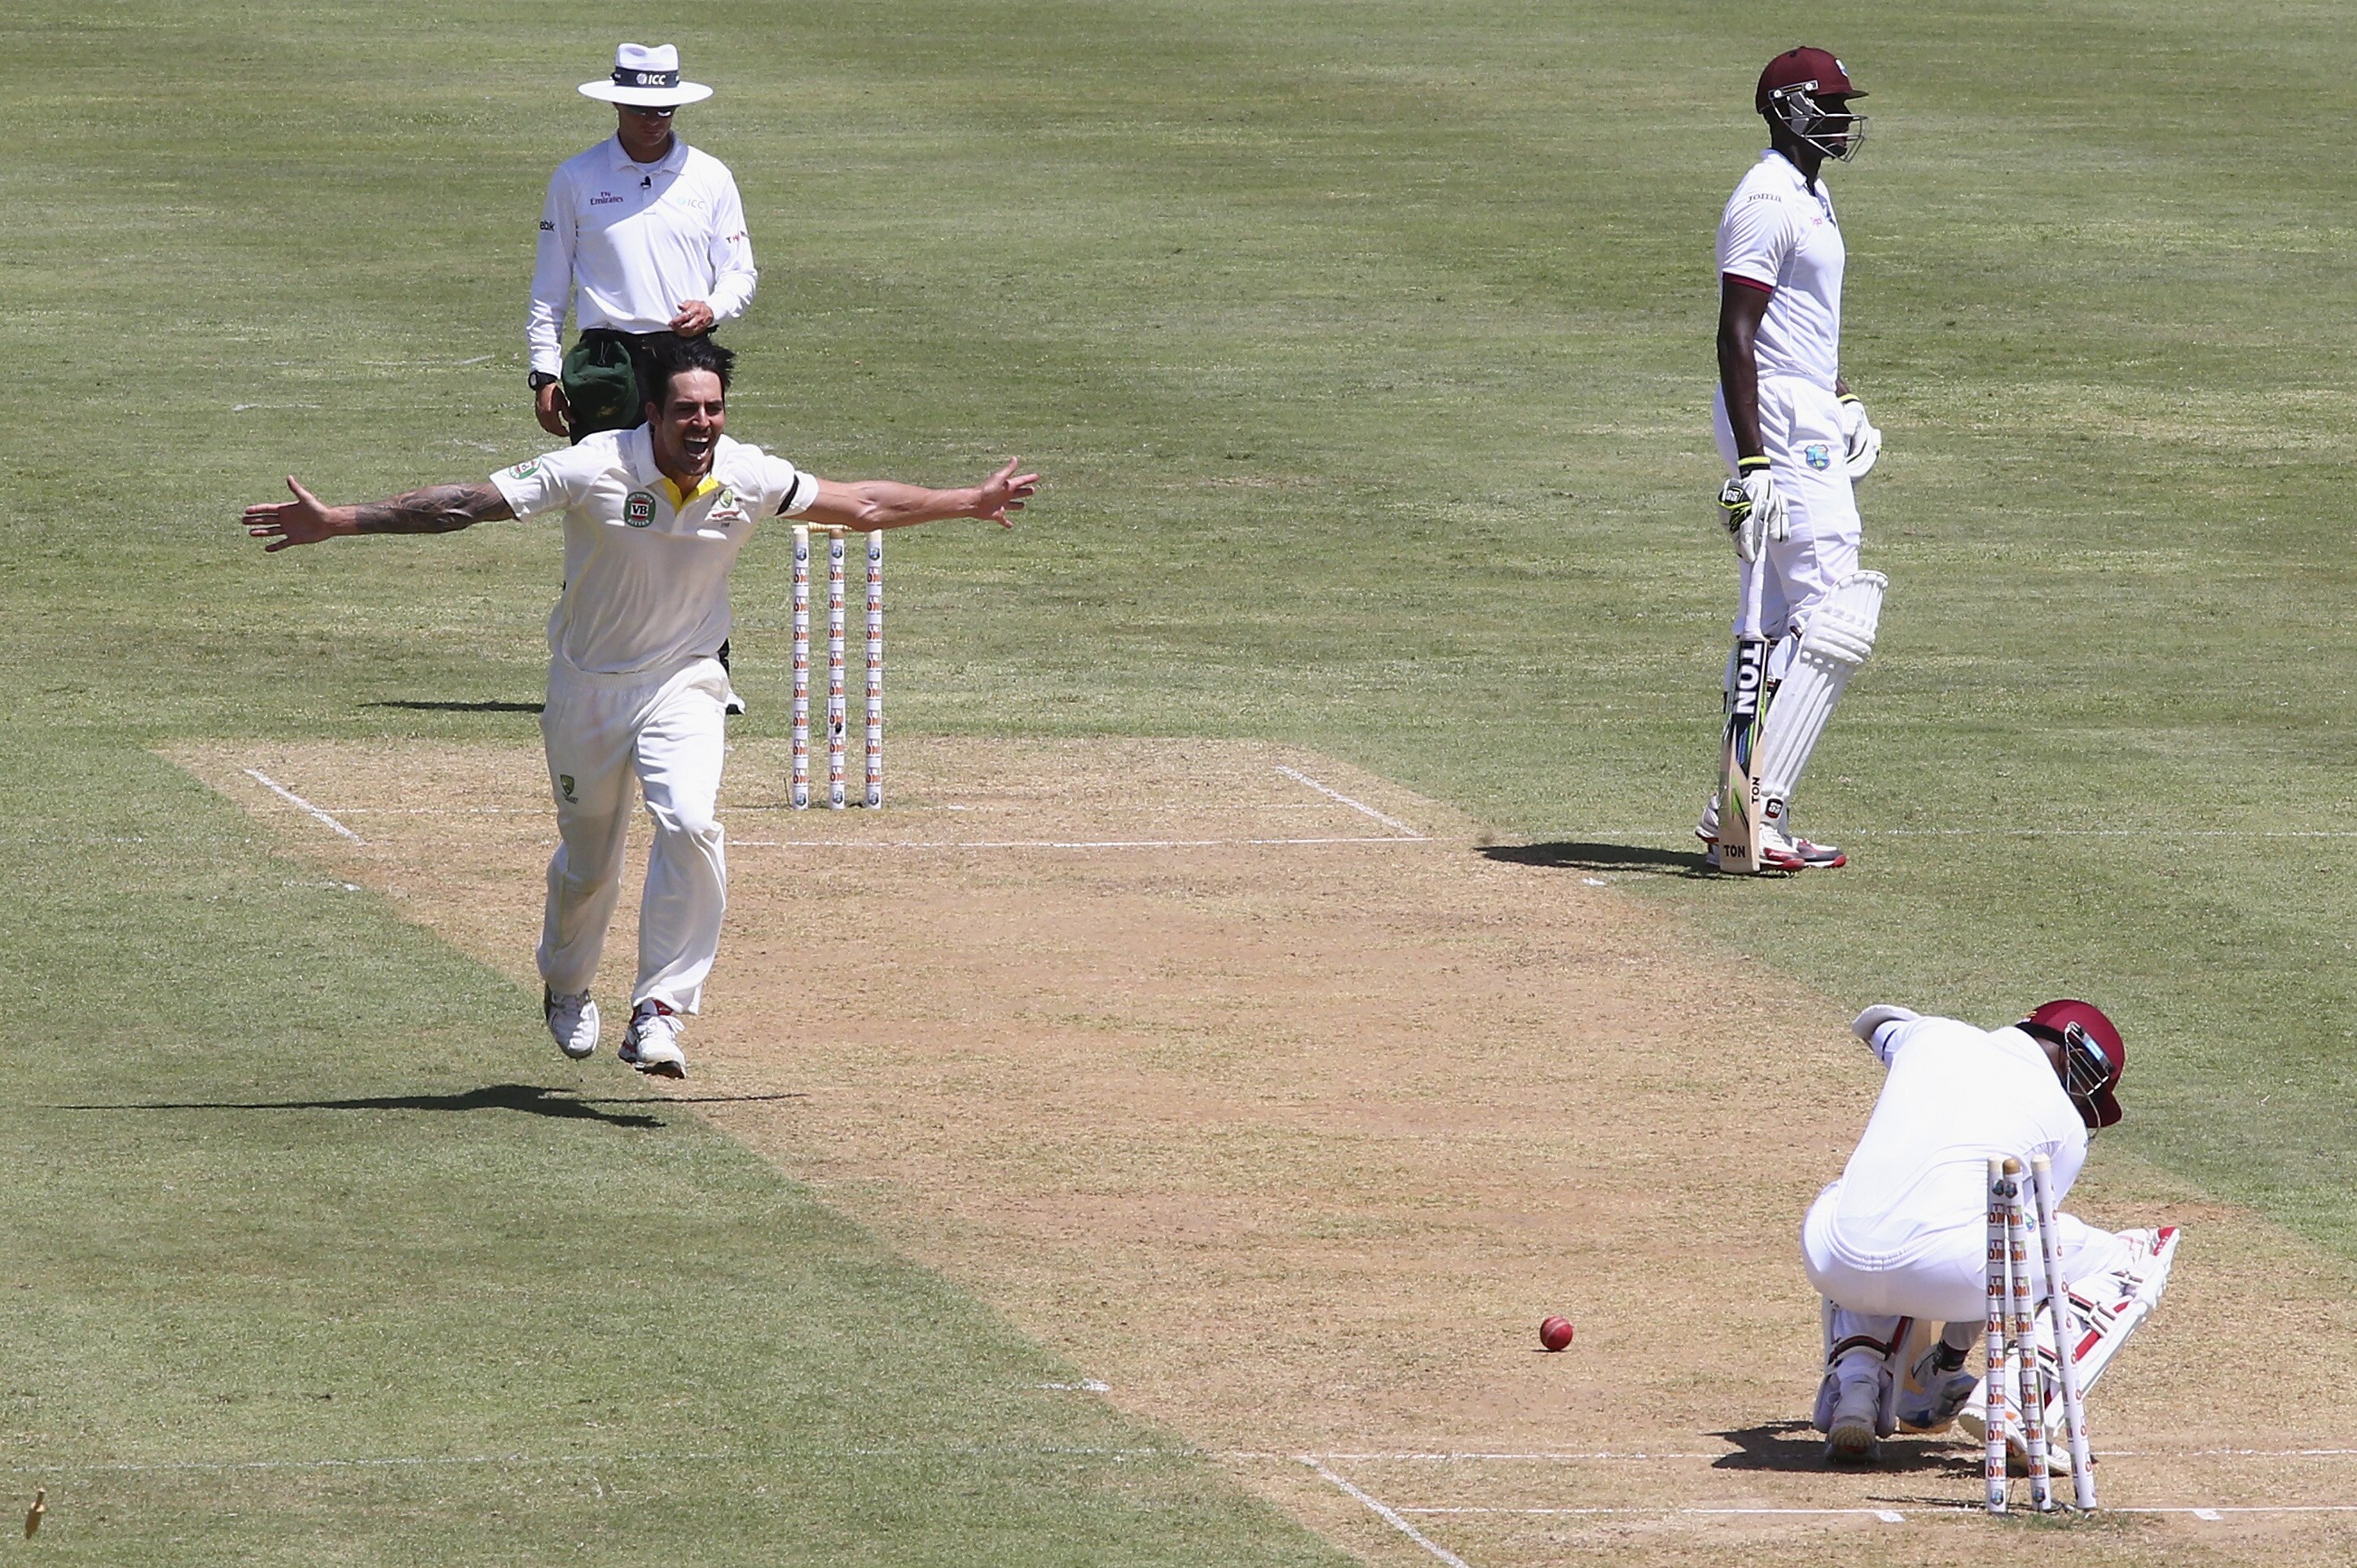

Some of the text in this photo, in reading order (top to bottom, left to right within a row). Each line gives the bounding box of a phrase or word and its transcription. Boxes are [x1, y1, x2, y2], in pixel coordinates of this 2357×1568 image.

[649, 75, 666, 85] ICC
[590, 196, 623, 205] Emirates
[688, 199, 705, 209] ICC
[631, 504, 648, 515] VB
[1734, 643, 1762, 714] TON
[1752, 776, 1761, 804] TON
[1724, 845, 1745, 858] TON
